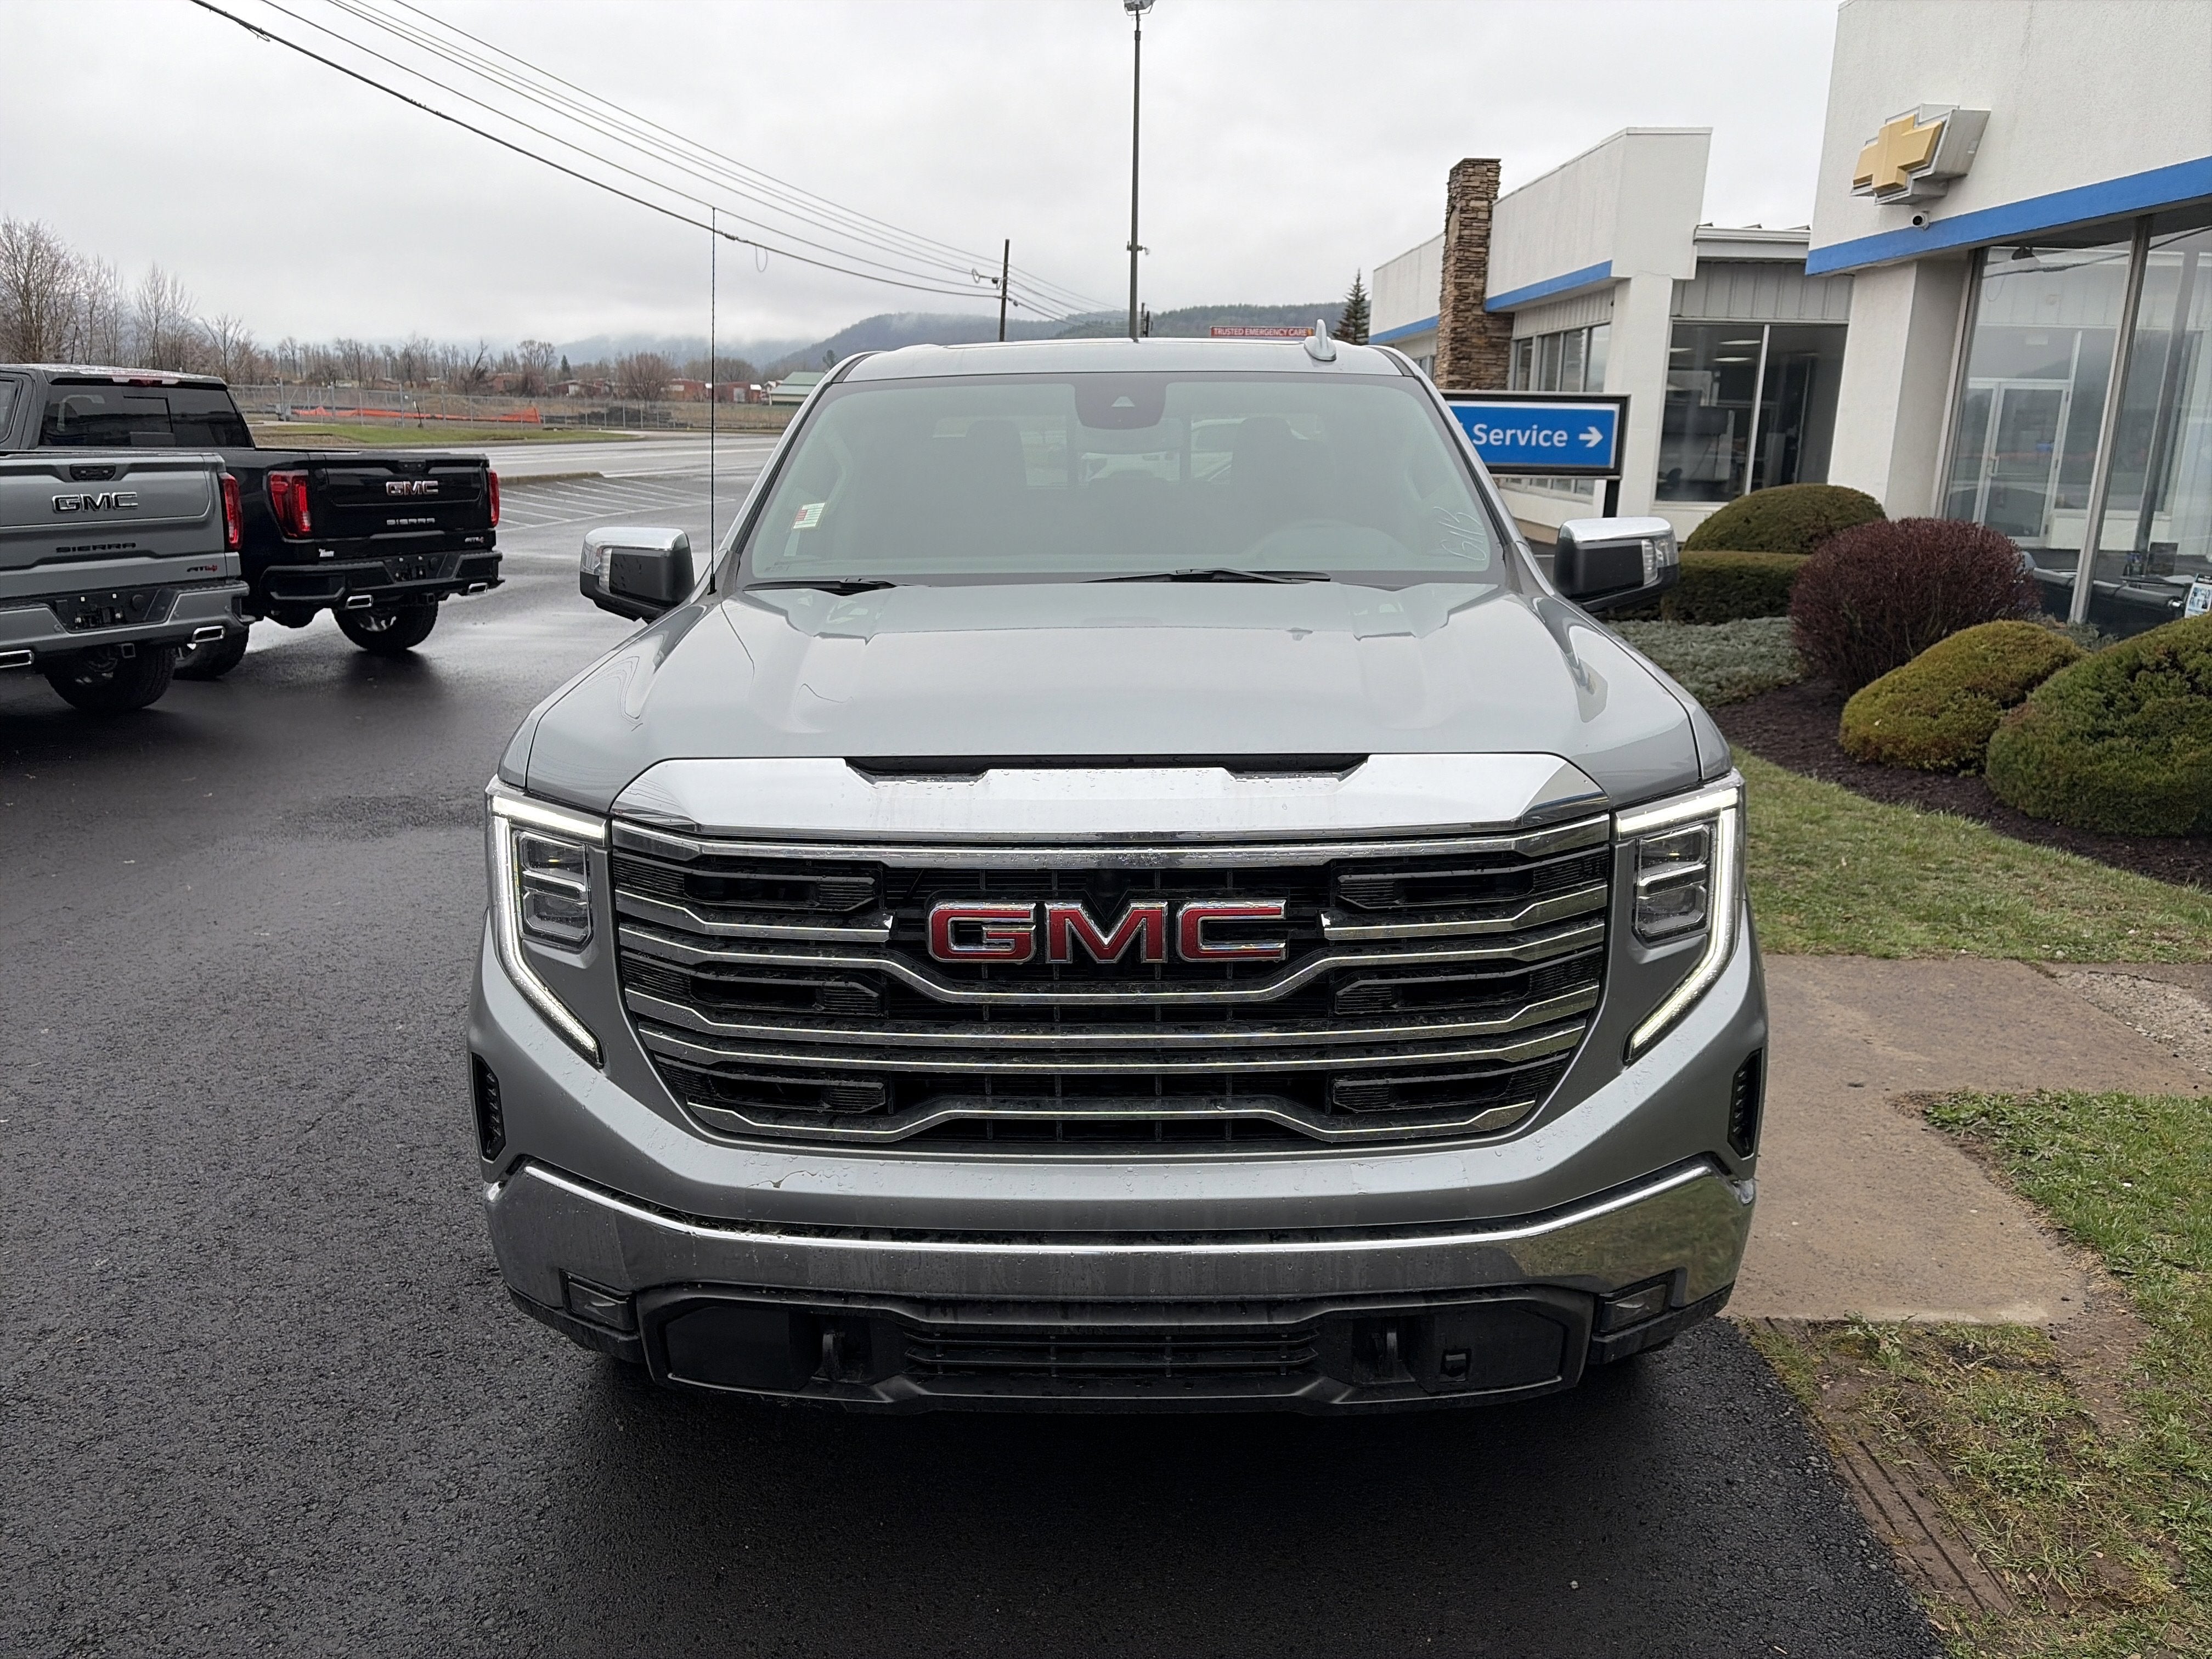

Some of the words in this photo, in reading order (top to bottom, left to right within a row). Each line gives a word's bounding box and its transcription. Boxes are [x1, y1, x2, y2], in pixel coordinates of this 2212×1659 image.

[1213, 328, 1244, 336] TRUSTED
[1245, 328, 1288, 336] EMERGENCY
[1472, 423, 1568, 447] Service
[386, 480, 438, 496] GMC
[52, 492, 138, 514] GMC
[386, 517, 435, 526] SIERRA
[56, 542, 137, 553] SIERRA
[927, 899, 1286, 963] GMC
